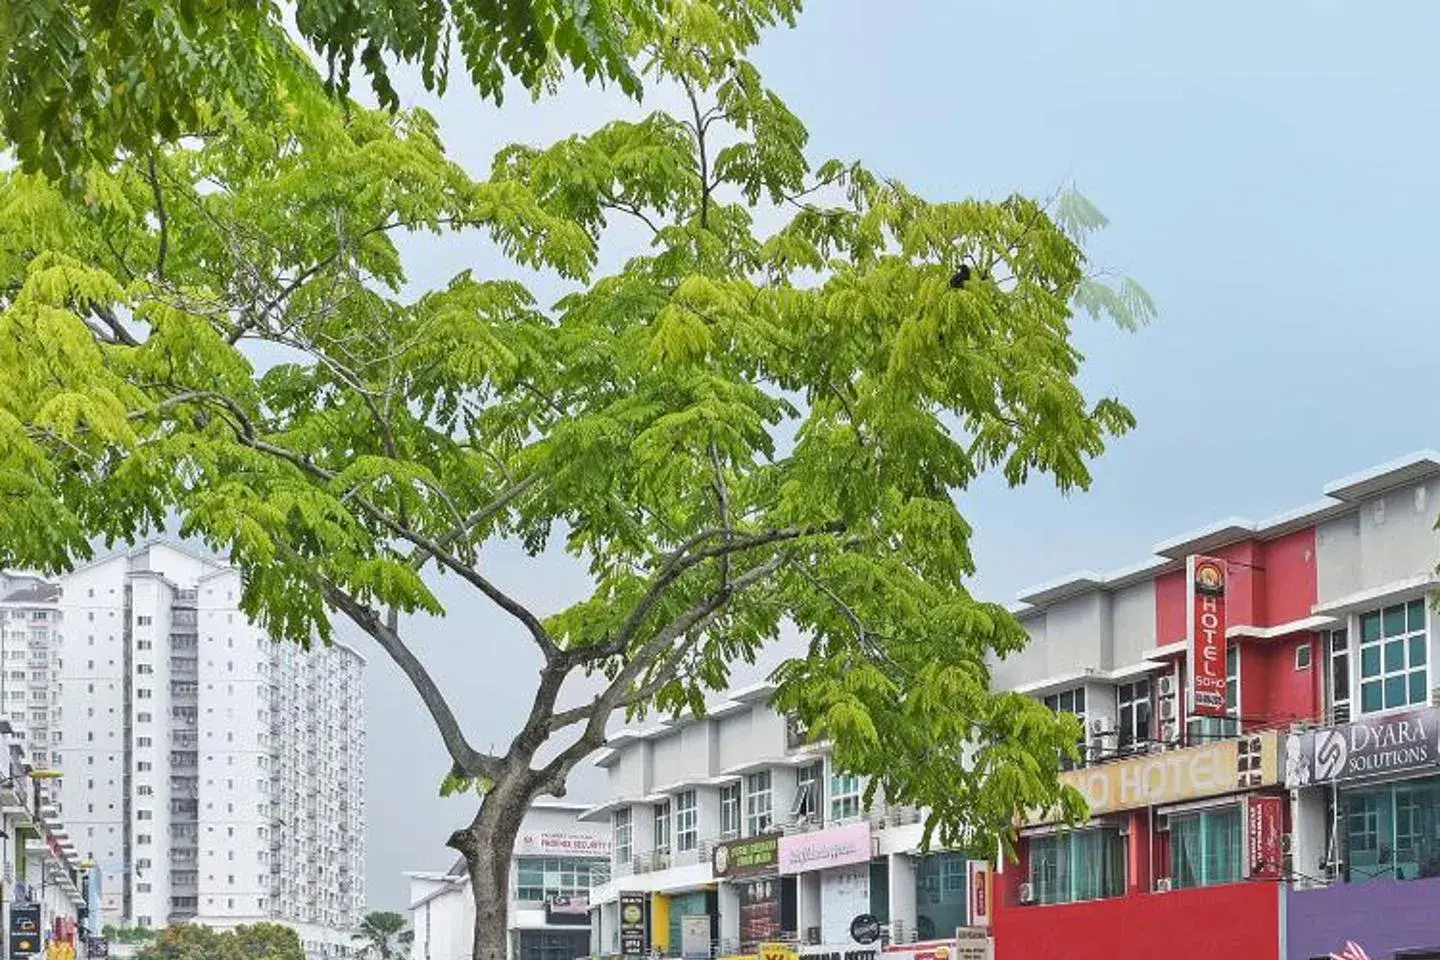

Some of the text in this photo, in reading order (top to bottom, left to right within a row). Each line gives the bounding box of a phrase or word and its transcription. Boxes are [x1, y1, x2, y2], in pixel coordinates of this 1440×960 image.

[1201, 597, 1218, 677] HOTEL
[1351, 718, 1429, 752] DYARA
[1119, 750, 1231, 803] HOTEL
[1350, 744, 1428, 773] SOLUTIONS
